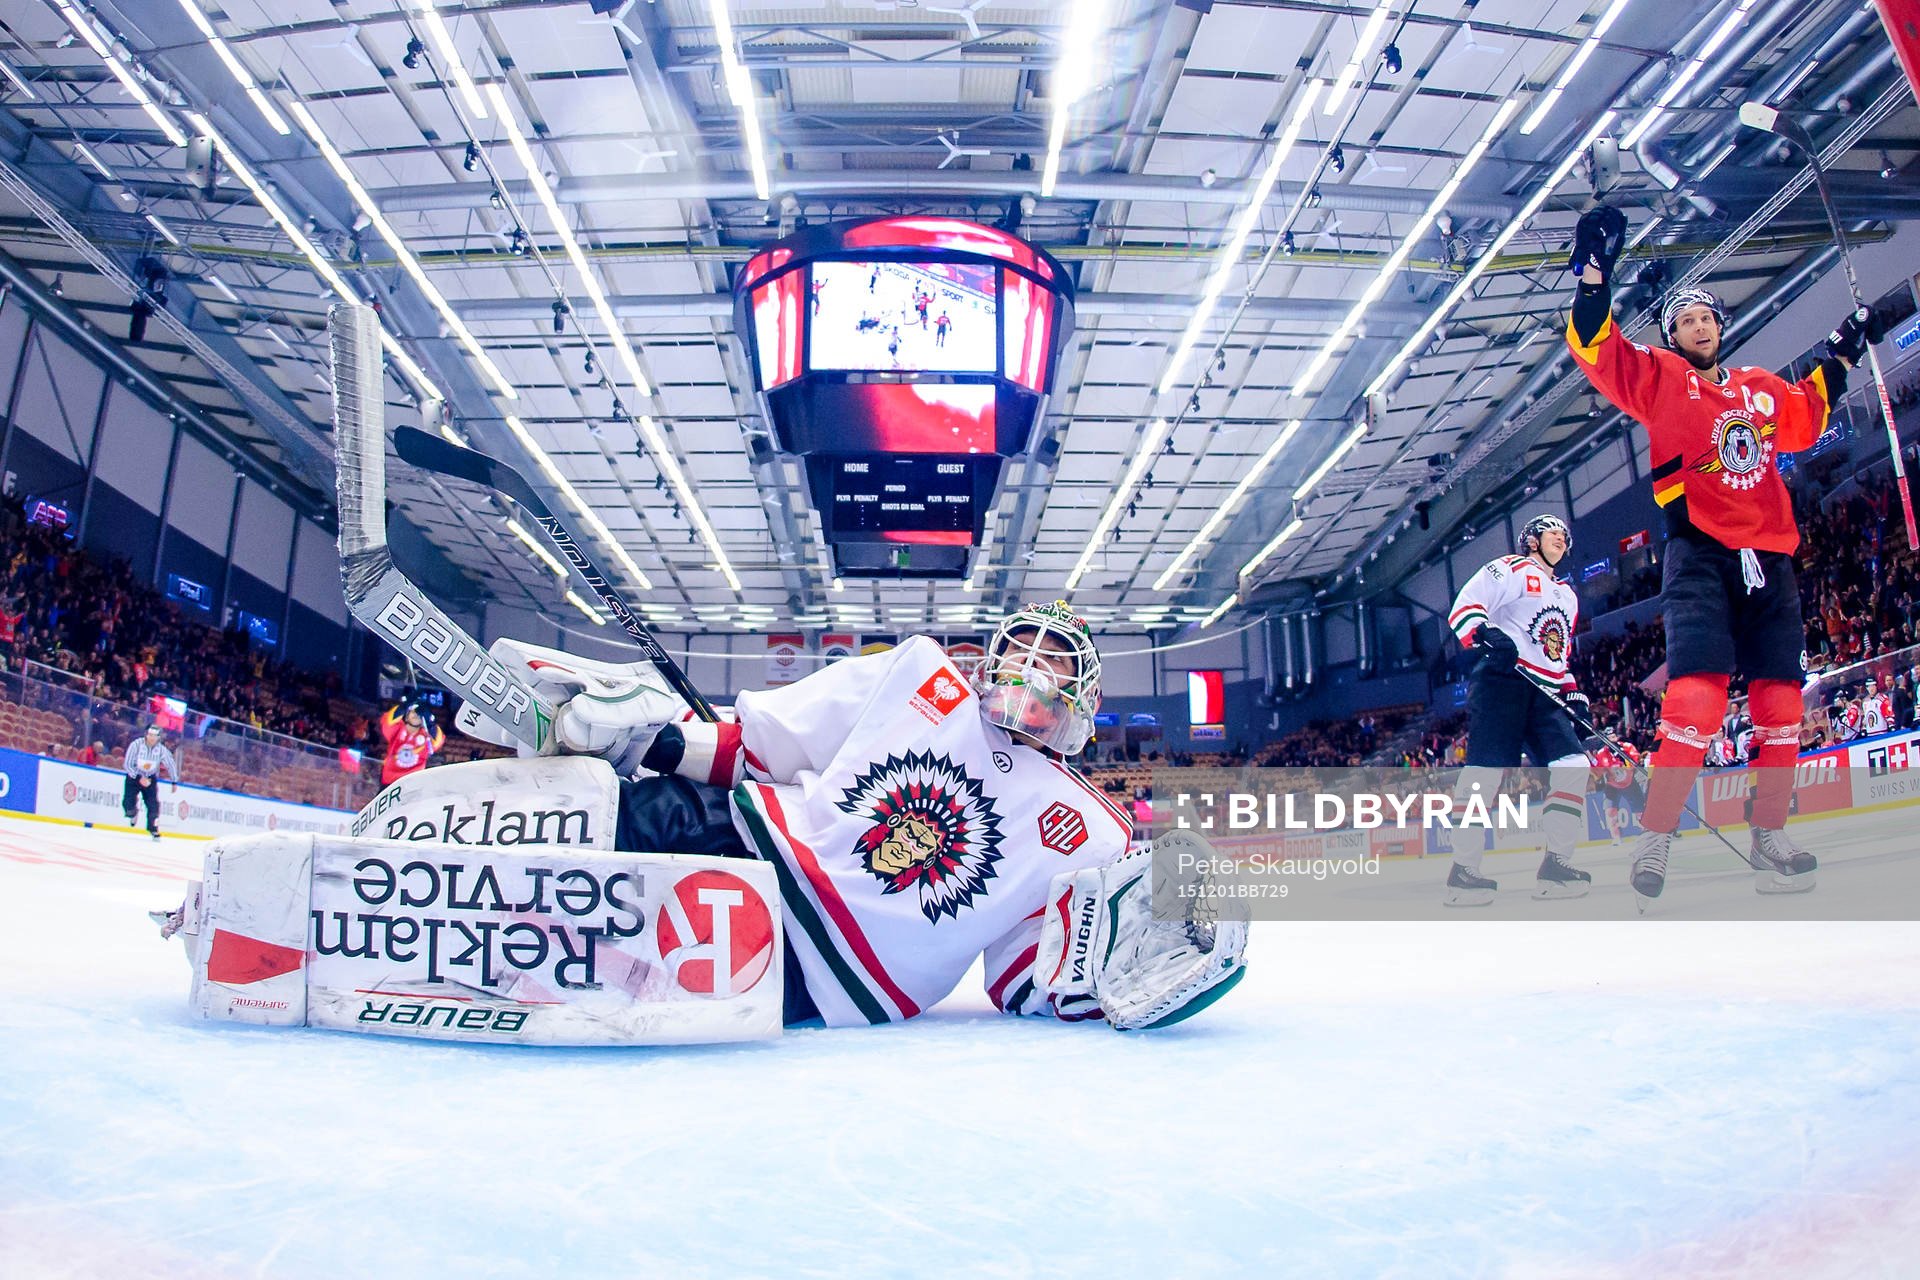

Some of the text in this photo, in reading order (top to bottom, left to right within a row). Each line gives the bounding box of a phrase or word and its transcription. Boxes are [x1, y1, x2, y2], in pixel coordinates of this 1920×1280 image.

[844, 463, 869, 473] HOME
[937, 464, 965, 474] GUEST
[854, 494, 879, 502] PENALTY
[945, 495, 970, 503] PENALTY
[536, 516, 669, 664] EASTON
[374, 591, 531, 726] BAUER
[77, 786, 121, 808] CHAMPIONS
[1870, 781, 1905, 799] SWISS
[189, 805, 223, 822] CHAMPIONS
[386, 800, 594, 846] Reklam
[1336, 832, 1365, 848] TISSOT
[353, 857, 646, 938] Service
[311, 909, 604, 990] Reklam
[1071, 896, 1097, 983] VAUGHN
[357, 1000, 532, 1034] BAUER
